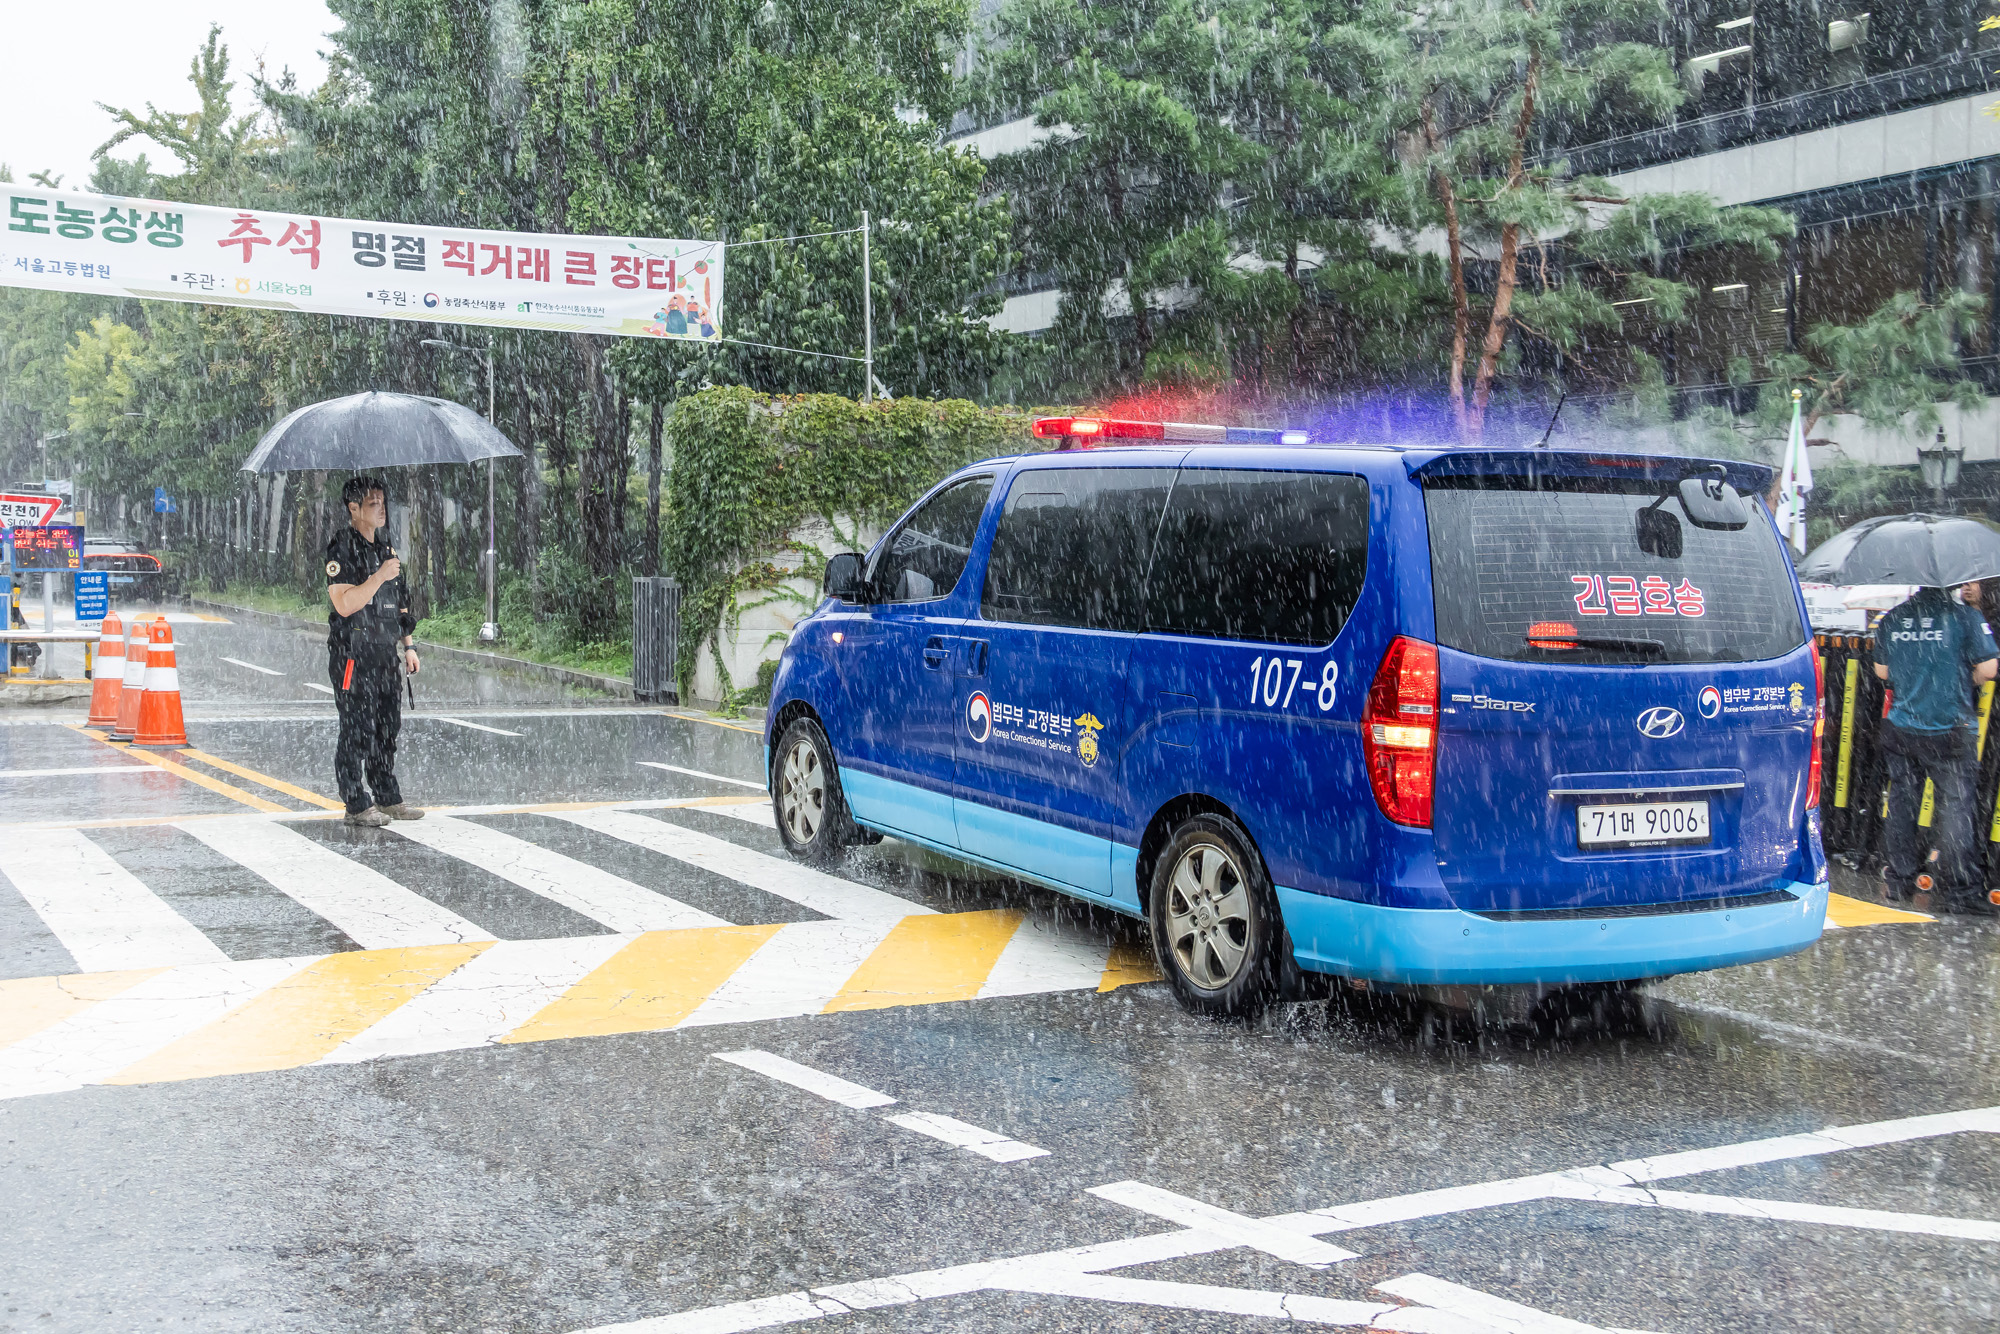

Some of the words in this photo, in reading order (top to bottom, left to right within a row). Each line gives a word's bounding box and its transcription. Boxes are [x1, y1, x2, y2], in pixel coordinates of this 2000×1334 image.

[8, 195, 185, 248] 도농상생
[217, 212, 322, 270] 추석
[351, 230, 426, 271] 명절
[441, 239, 550, 283] 직거래
[563, 251, 597, 286] 큰
[610, 254, 676, 292] 장터
[13, 257, 111, 280] 서울고등법원
[256, 280, 312, 296] 서울농협
[444, 296, 506, 311] 농림축산식품부
[0, 504, 40, 518] 천천히
[7, 518, 34, 526] SLOW
[1571, 574, 1706, 617] 긴급호송
[1891, 630, 1944, 641] POLICE
[1250, 656, 1338, 711] 107-8
[1723, 687, 1750, 703] 법무부
[1752, 686, 1785, 701] 교정본부
[1472, 695, 1536, 713] Starex
[1723, 705, 1739, 713] Korea
[1739, 704, 1768, 712] Correctional
[1769, 702, 1785, 710] Service
[992, 701, 1024, 727] 법무부
[1027, 708, 1072, 737] 교정본부
[992, 726, 1009, 740] Korea
[1010, 730, 1047, 748] Correctional
[1048, 739, 1072, 754] Service
[1592, 810, 1635, 837] 71머
[1645, 807, 1698, 834] 9006
